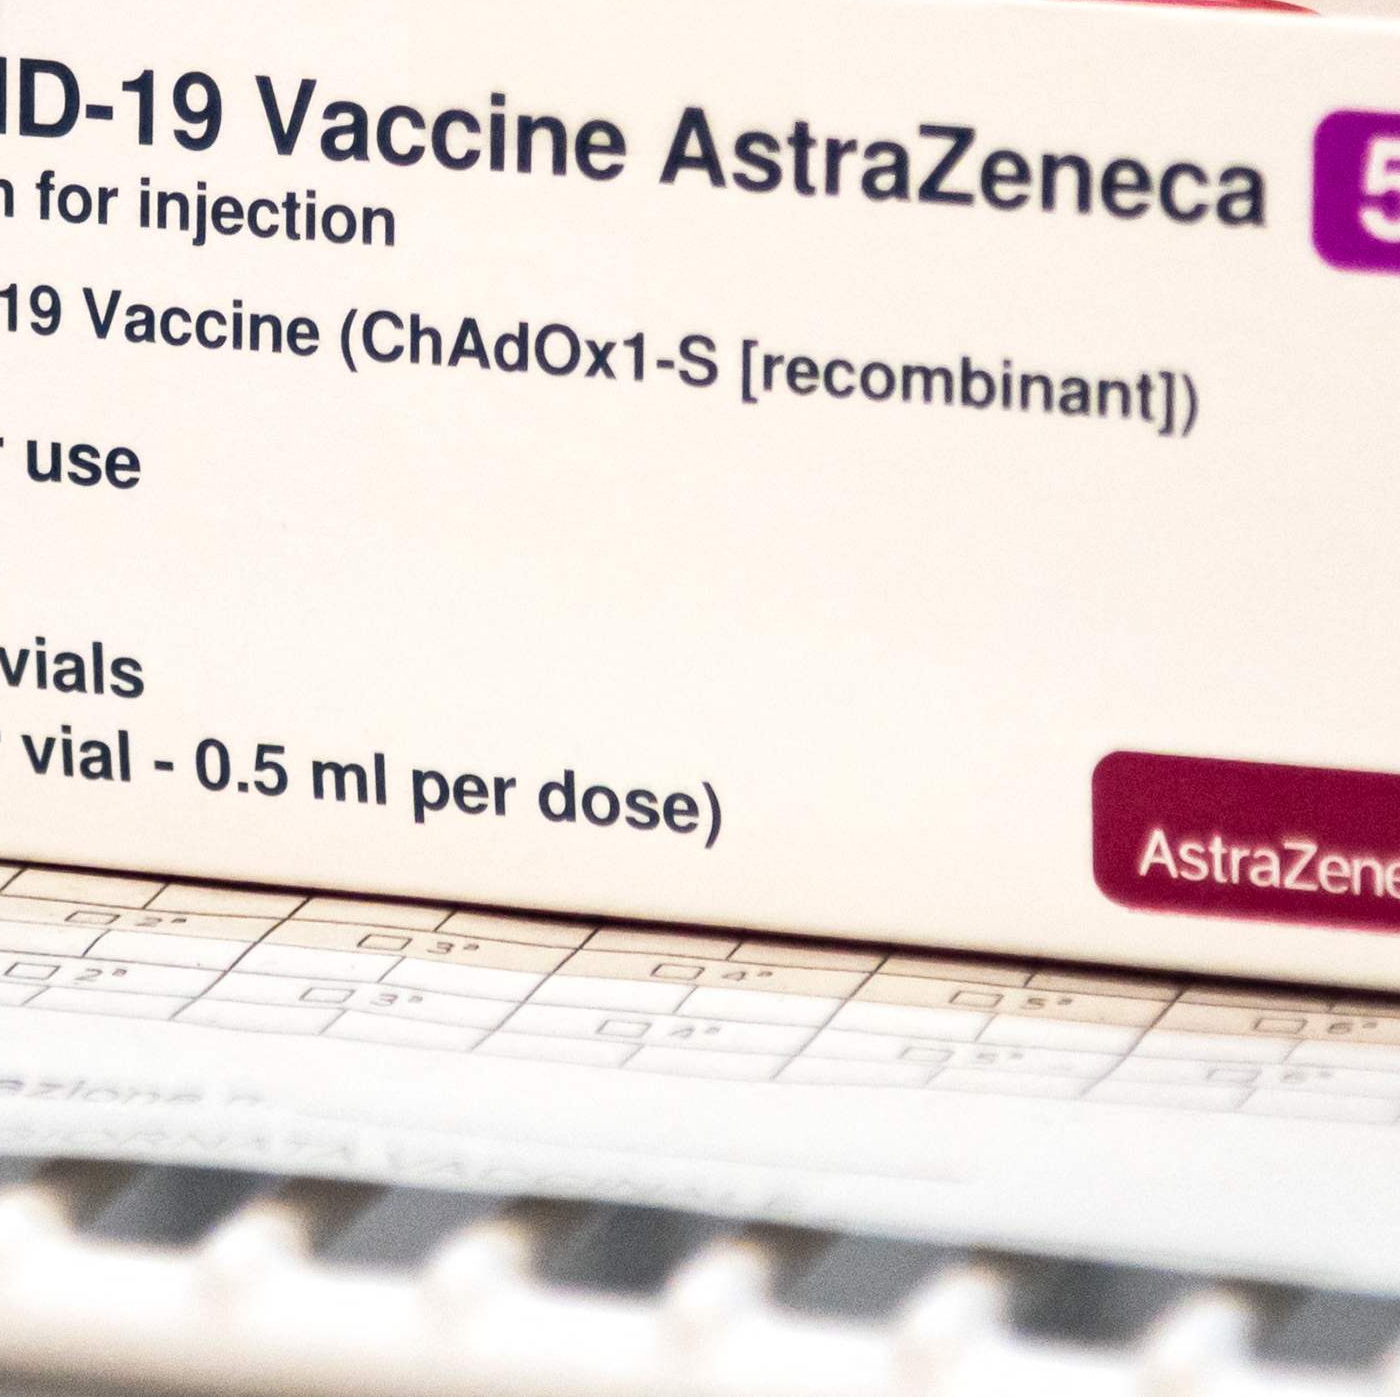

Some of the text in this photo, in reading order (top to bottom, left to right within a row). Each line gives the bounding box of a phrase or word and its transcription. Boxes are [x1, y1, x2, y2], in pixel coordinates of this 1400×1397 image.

[36, 169, 119, 226] for
[139, 176, 397, 248] injection
[254, 74, 628, 182] Vaccine
[659, 106, 1268, 229] AstraZeneca
[82, 287, 321, 357] Vaccine
[340, 308, 720, 389] (ChAdOx1-S
[741, 337, 1201, 438] [recombinant])
[25, 438, 142, 491] use
[21, 723, 132, 783] vial
[153, 760, 175, 772] -
[193, 736, 289, 798] 0.5
[311, 752, 387, 807] ml
[410, 767, 518, 825] per
[537, 768, 724, 850] dose)
